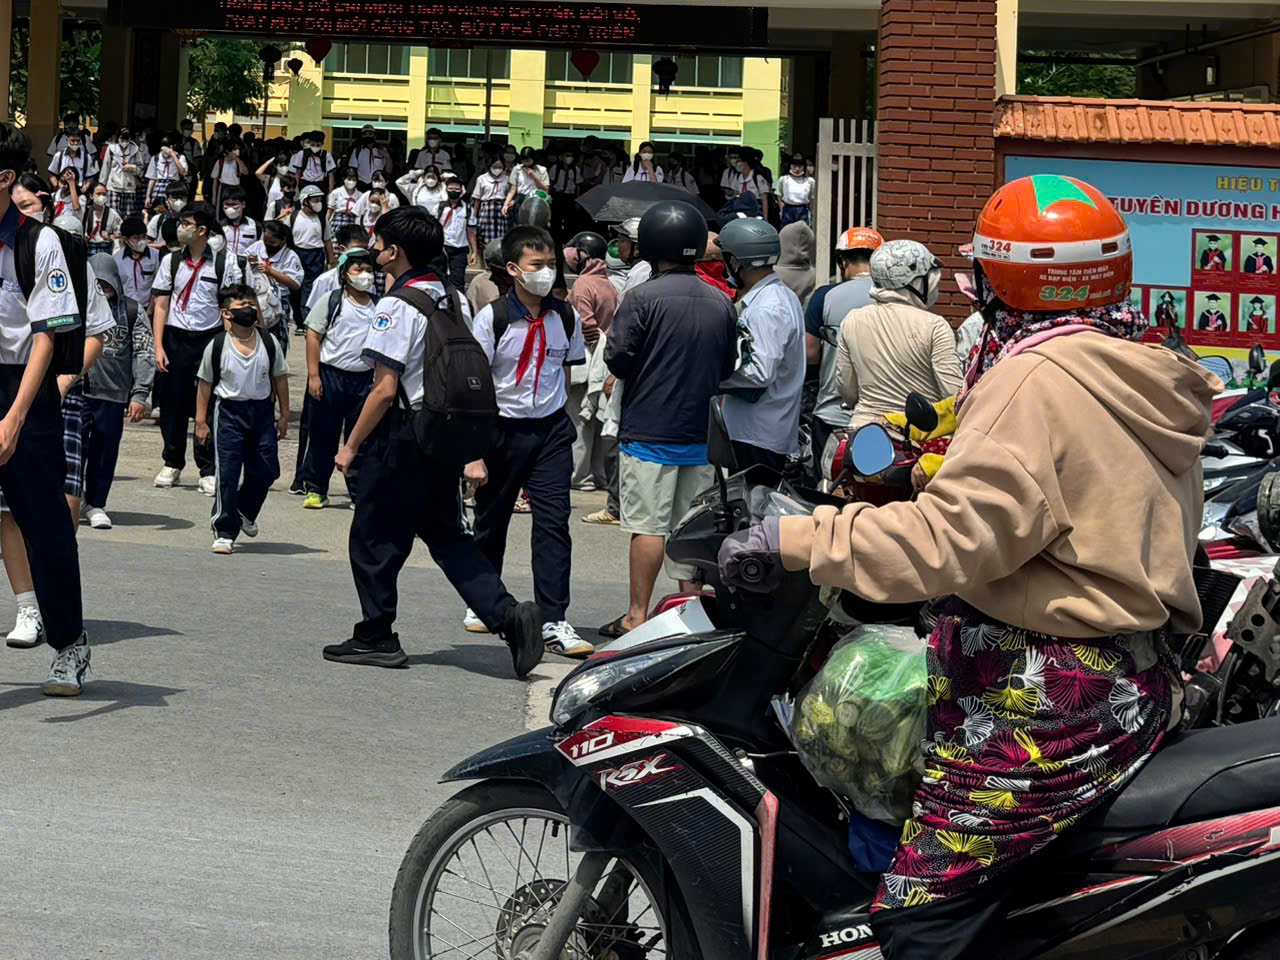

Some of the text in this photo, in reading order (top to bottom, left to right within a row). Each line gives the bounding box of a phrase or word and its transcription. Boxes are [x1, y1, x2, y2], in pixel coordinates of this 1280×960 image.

[1216, 175, 1263, 194] HIỆU
[1185, 198, 1266, 220] DƯƠNG
[989, 239, 1012, 253] 324
[1039, 285, 1090, 302] 324
[570, 731, 615, 759] 110
[819, 923, 874, 948] HON
